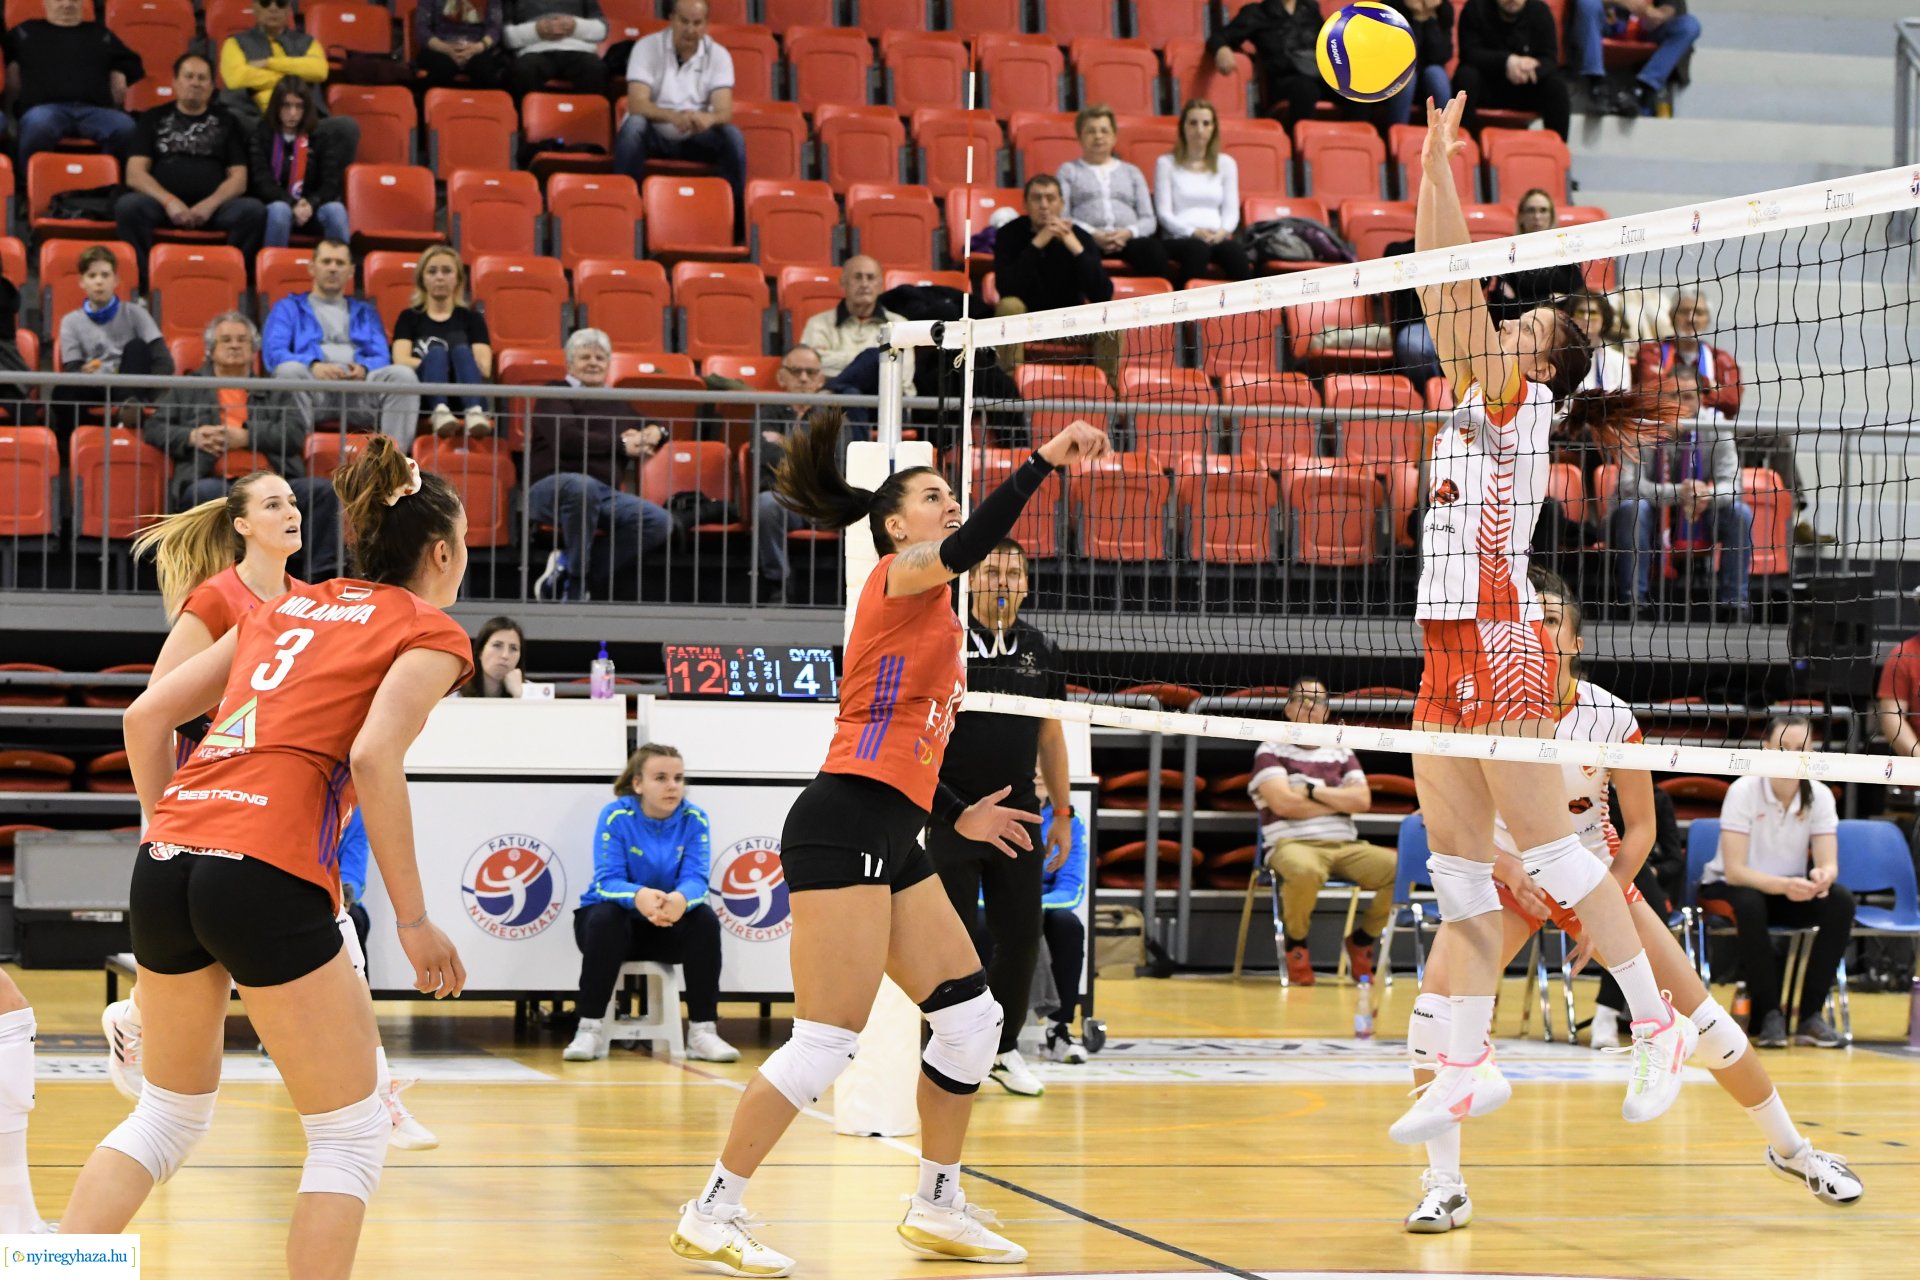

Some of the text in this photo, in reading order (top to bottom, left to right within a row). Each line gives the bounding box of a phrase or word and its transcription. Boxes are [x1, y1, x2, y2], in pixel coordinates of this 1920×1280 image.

[1330, 38, 1342, 65] V200W
[275, 595, 376, 625] MILANOVA
[250, 628, 315, 691] 3
[666, 646, 722, 660] FATUM
[673, 659, 821, 695] 12 4
[1459, 701, 1483, 715] EAT
[177, 788, 269, 807] BESTRONG
[488, 836, 541, 852] FATUM
[716, 905, 792, 940] NYÍREGYHA
[704, 1176, 725, 1204] MIKASA
[933, 1172, 950, 1201] MIKASA
